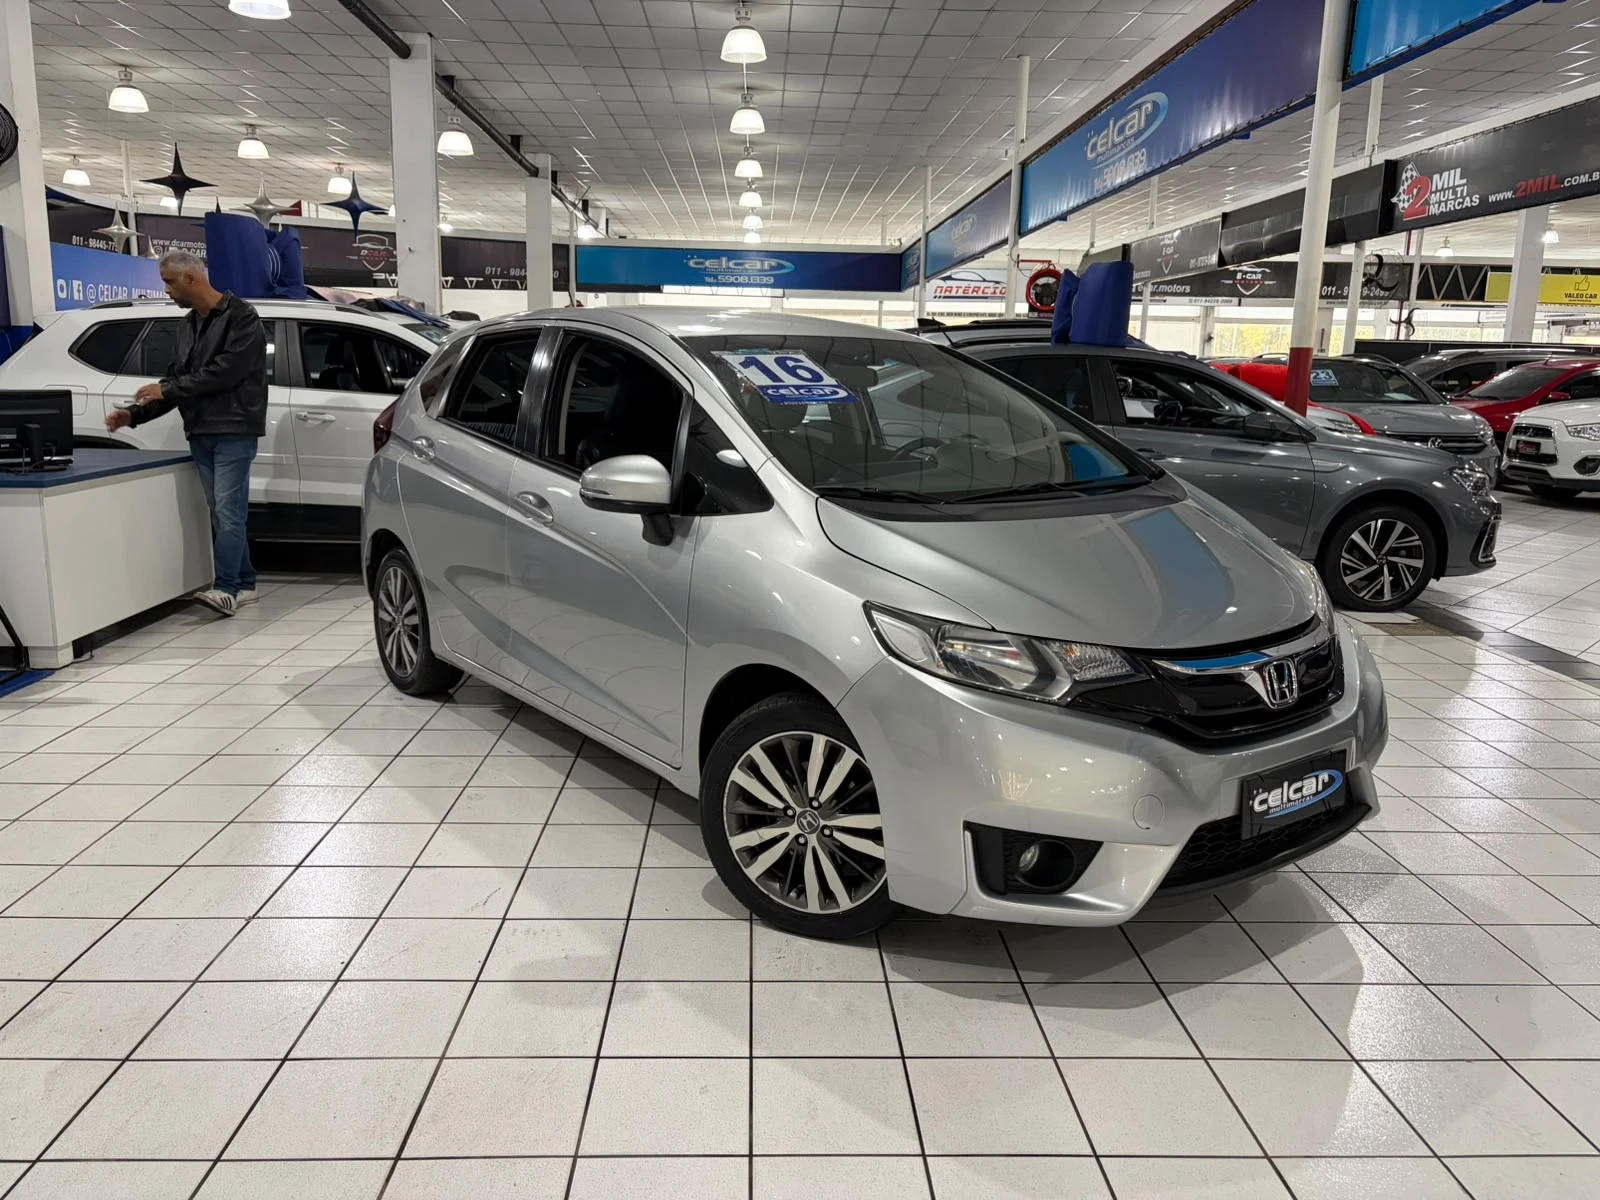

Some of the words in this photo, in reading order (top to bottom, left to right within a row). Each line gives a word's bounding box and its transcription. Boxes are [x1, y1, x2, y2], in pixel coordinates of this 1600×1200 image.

[1086, 101, 1153, 160] celcar
[1403, 176, 1431, 221] 2
[1432, 168, 1467, 192] MIL
[1430, 185, 1468, 204] MULTI
[1429, 195, 1480, 216] MARCAS
[72, 234, 83, 246] 011
[484, 266, 501, 275] 011
[687, 256, 778, 270] celcar
[1321, 285, 1336, 296] 011
[738, 356, 824, 383] 16
[767, 386, 834, 396] celcar
[1252, 772, 1329, 813] celcar
[1269, 794, 1314, 814] multimarcas
